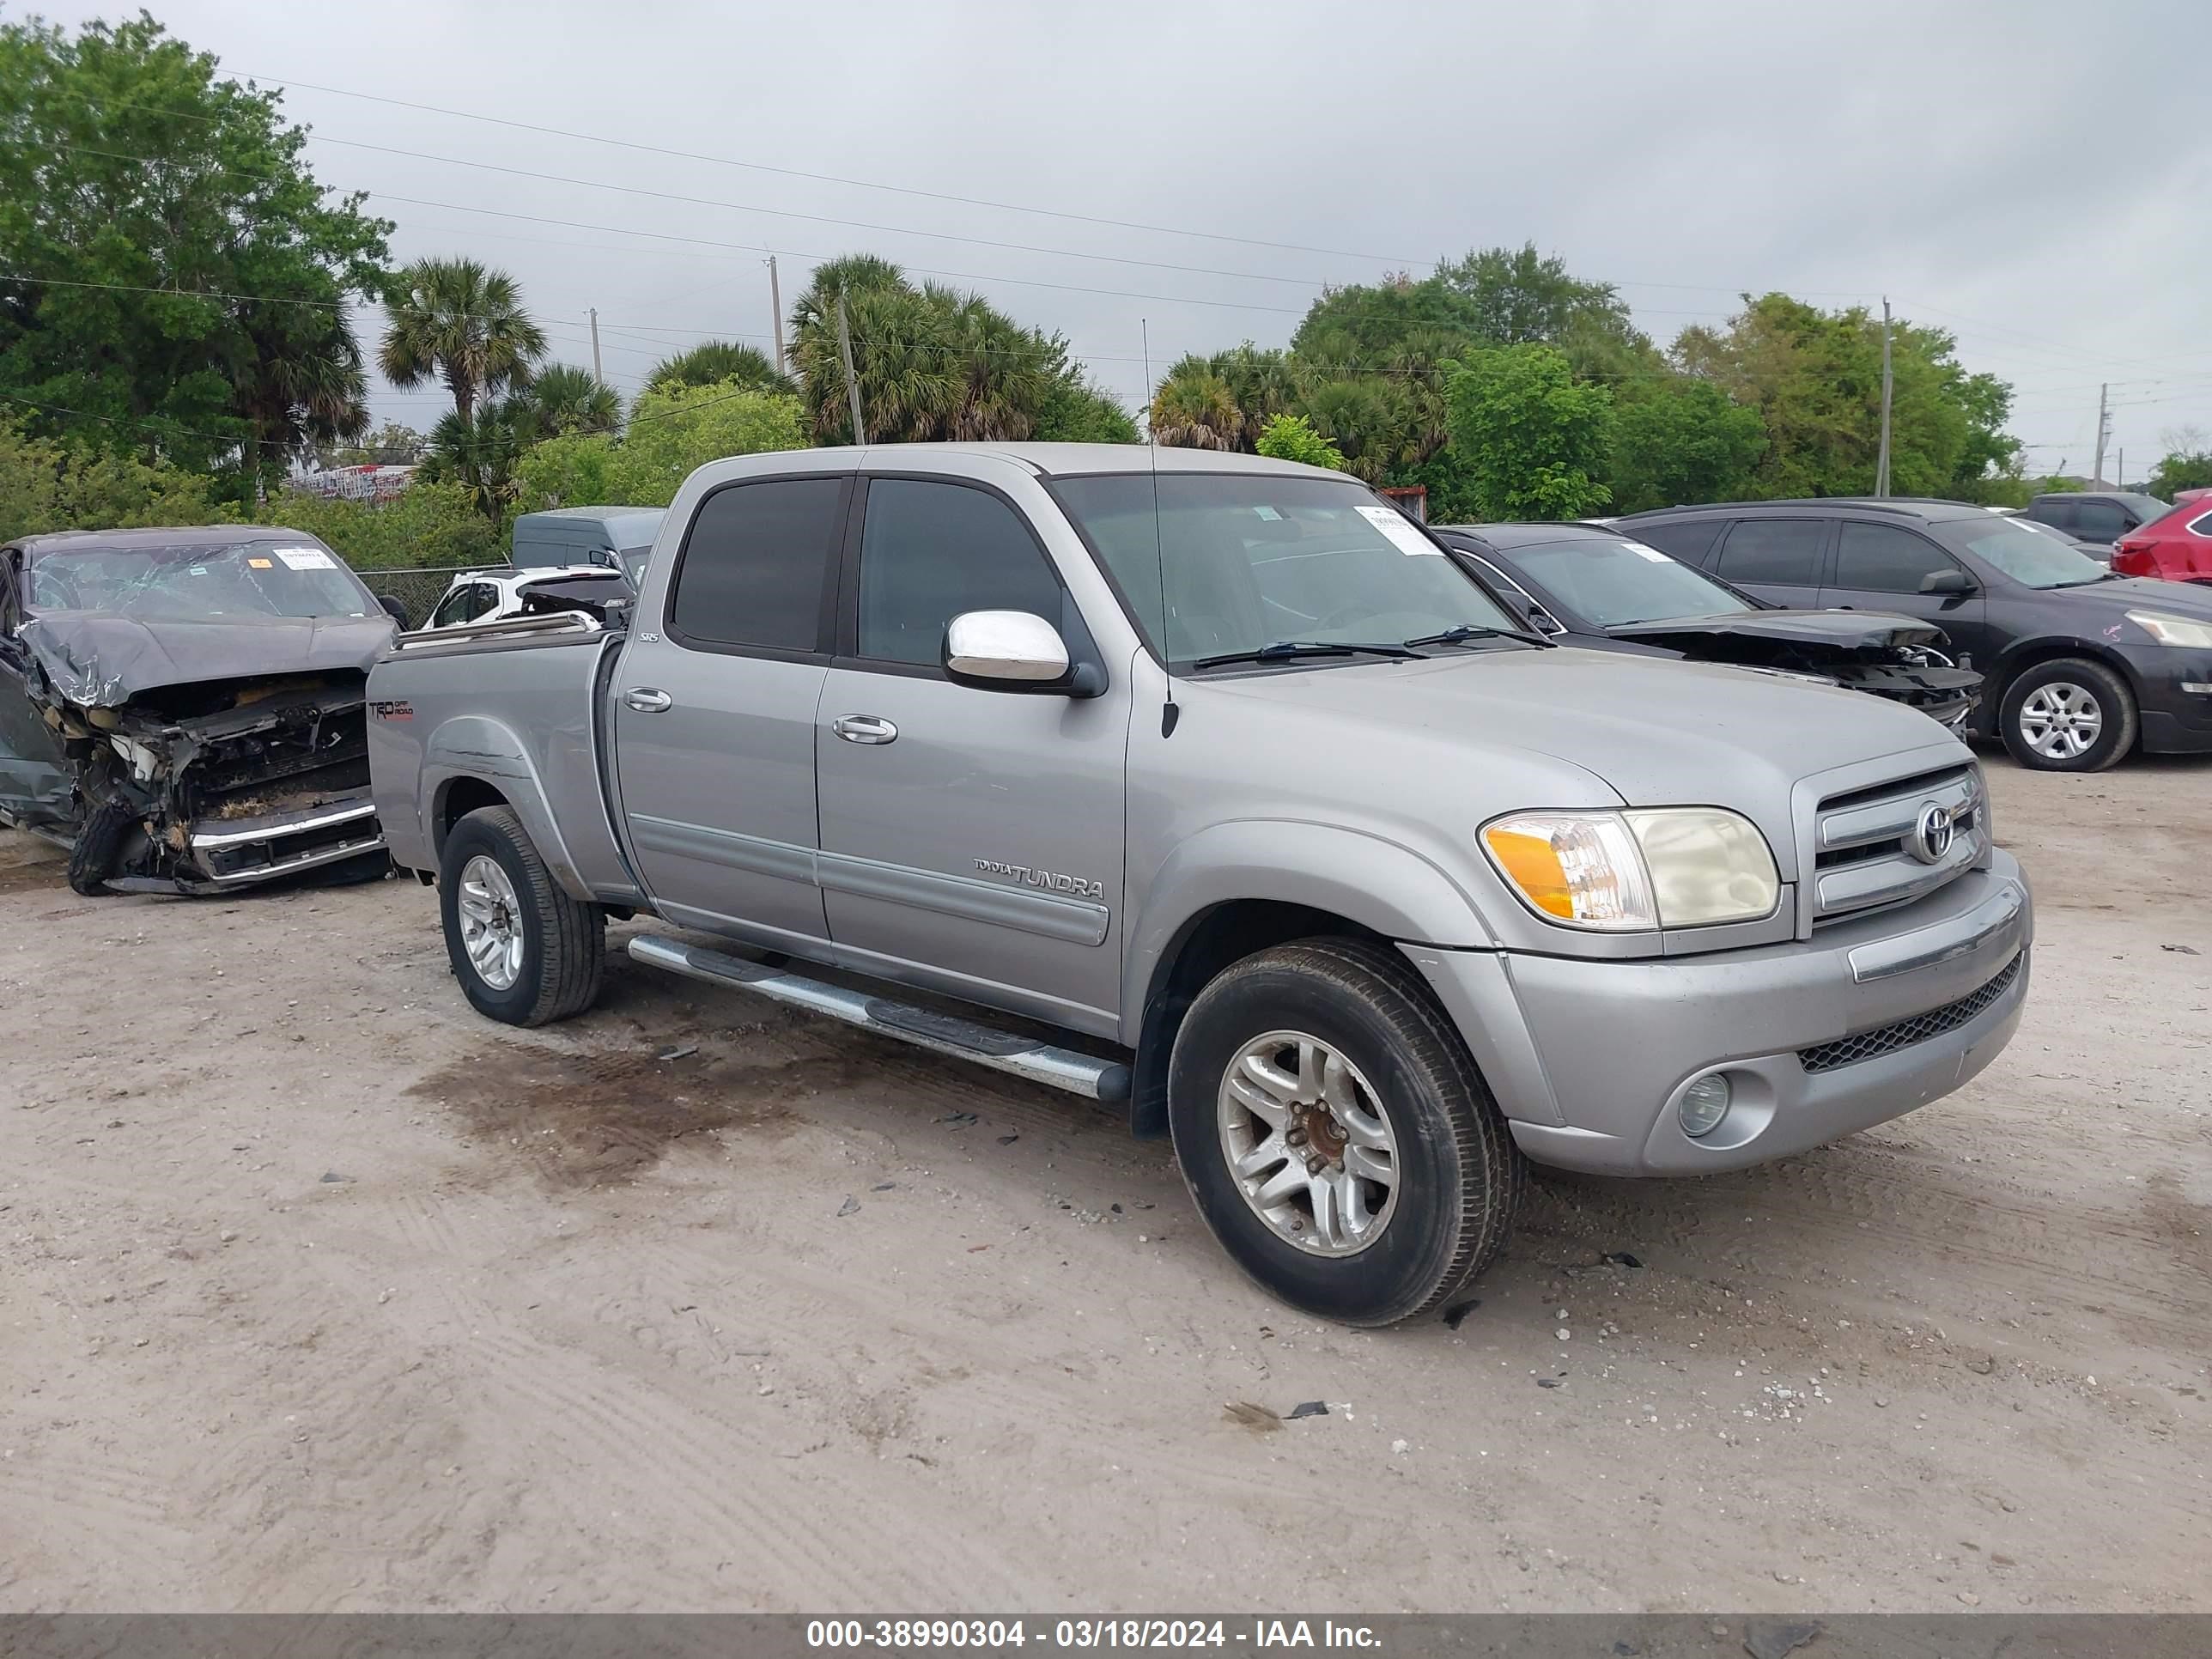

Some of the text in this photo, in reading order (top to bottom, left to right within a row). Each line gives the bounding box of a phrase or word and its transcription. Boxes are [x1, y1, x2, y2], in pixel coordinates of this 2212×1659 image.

[368, 701, 394, 720] TRD
[973, 858, 1104, 900] TOYOTA TUNDRA
